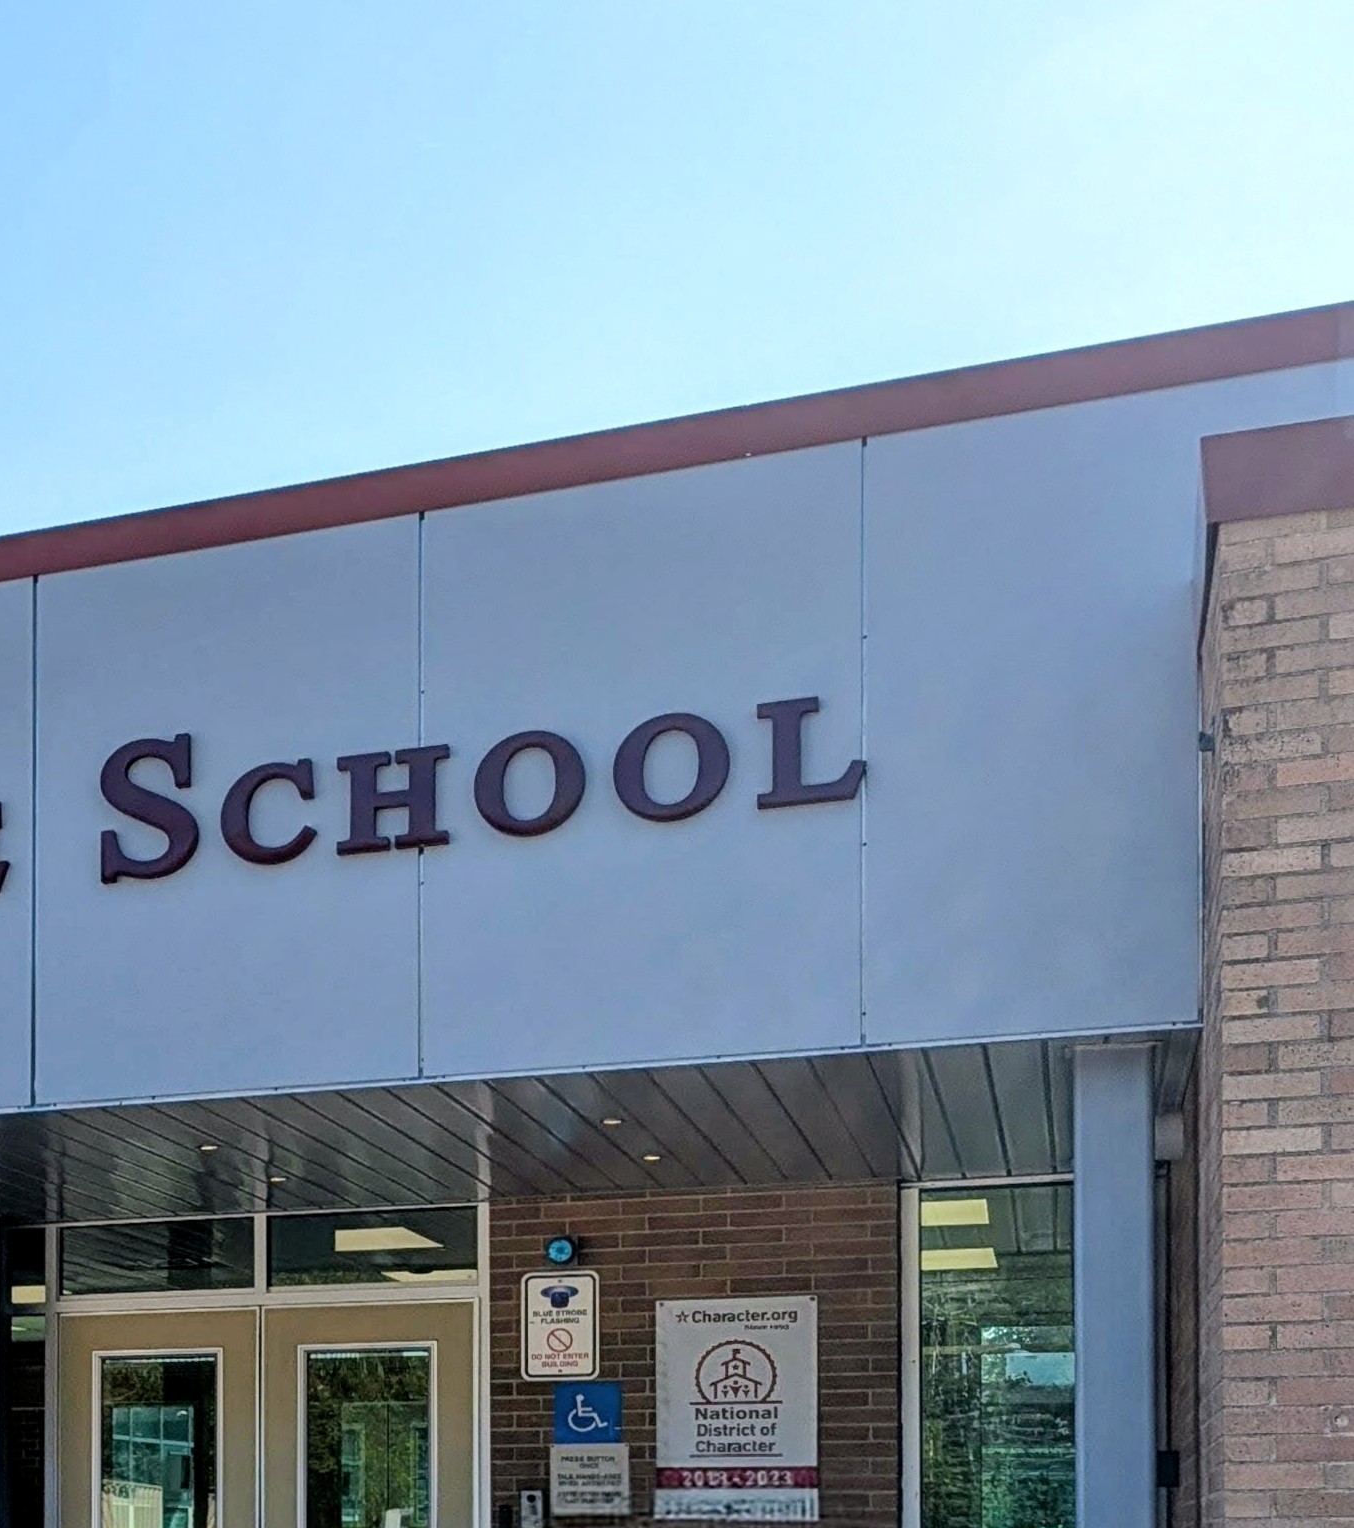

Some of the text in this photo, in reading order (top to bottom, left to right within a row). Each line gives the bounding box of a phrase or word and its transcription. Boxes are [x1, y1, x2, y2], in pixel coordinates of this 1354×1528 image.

[99, 696, 867, 885] SCHOOL
[692, 1310, 798, 1323] Character.org
[563, 1352, 589, 1360] ENTER
[541, 1360, 579, 1368] BUILDING
[694, 1407, 778, 1421] National
[696, 1423, 777, 1437] District of
[695, 1440, 776, 1453] Character
